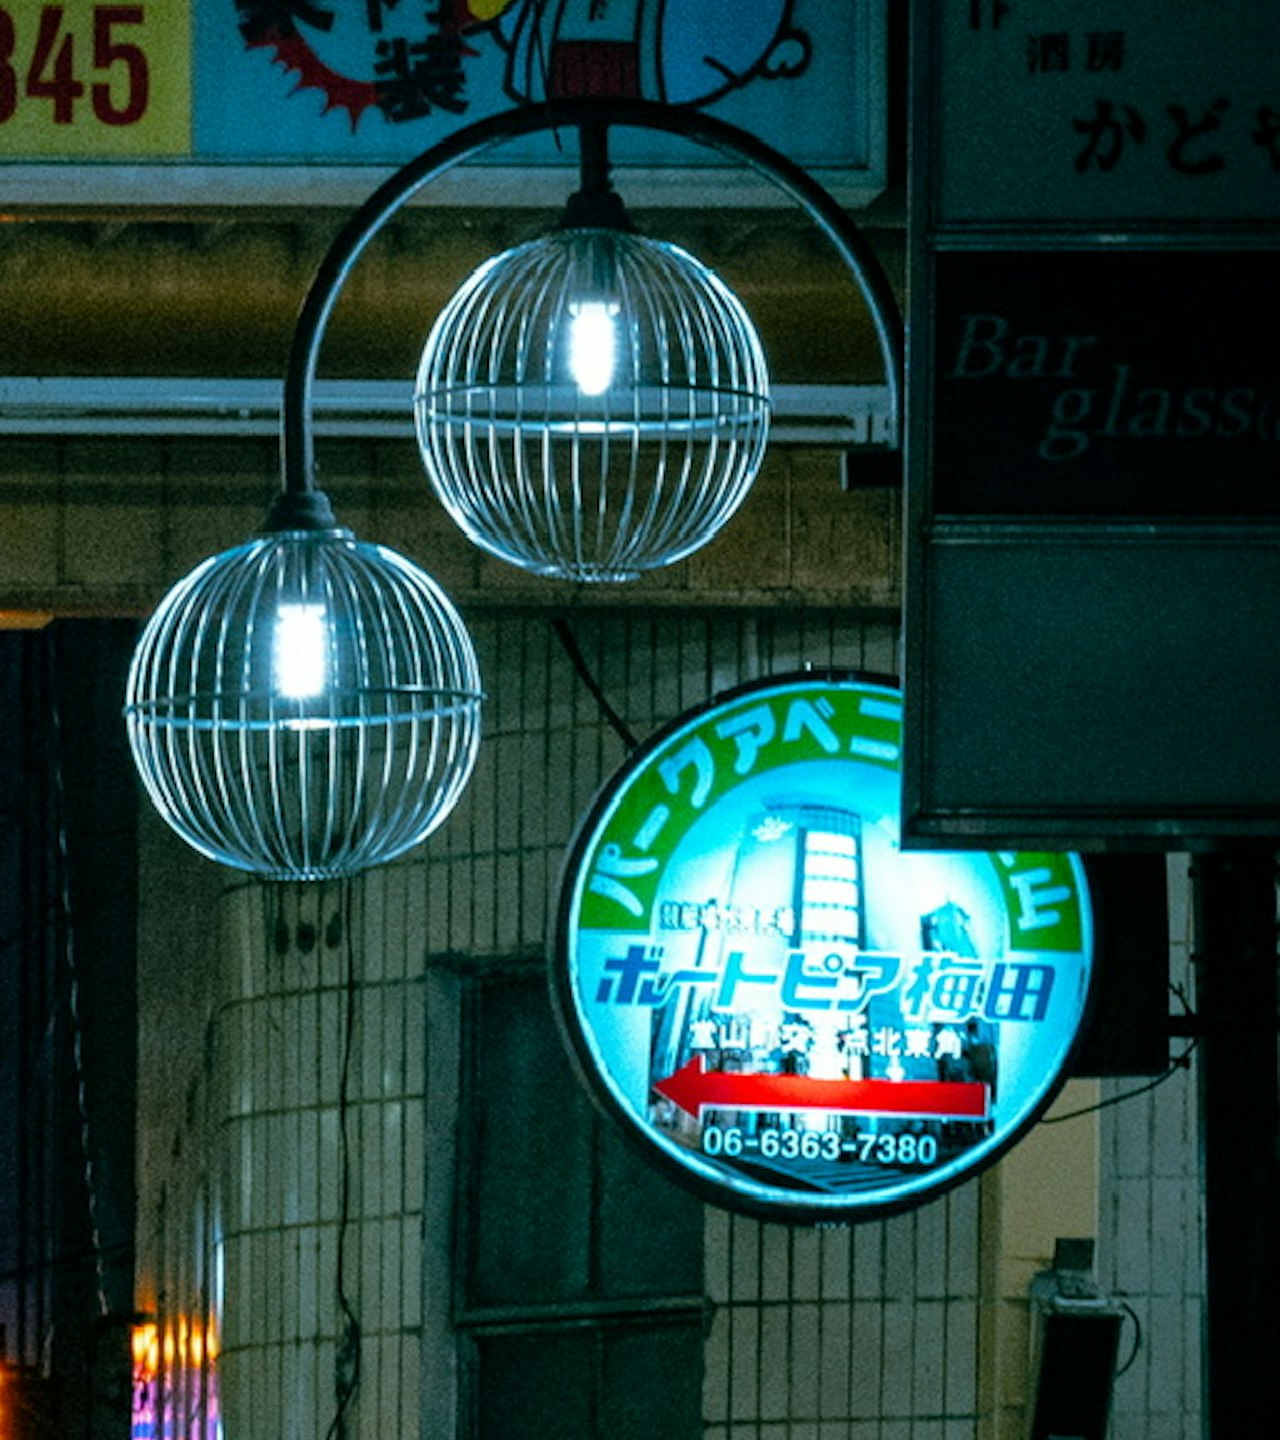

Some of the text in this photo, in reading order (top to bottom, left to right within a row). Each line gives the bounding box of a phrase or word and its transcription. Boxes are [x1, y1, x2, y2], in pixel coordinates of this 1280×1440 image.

[942, 312, 1100, 380] Bar
[594, 944, 1056, 1022] ボートピア梅田
[702, 1124, 938, 1164] 06-6363-7380
